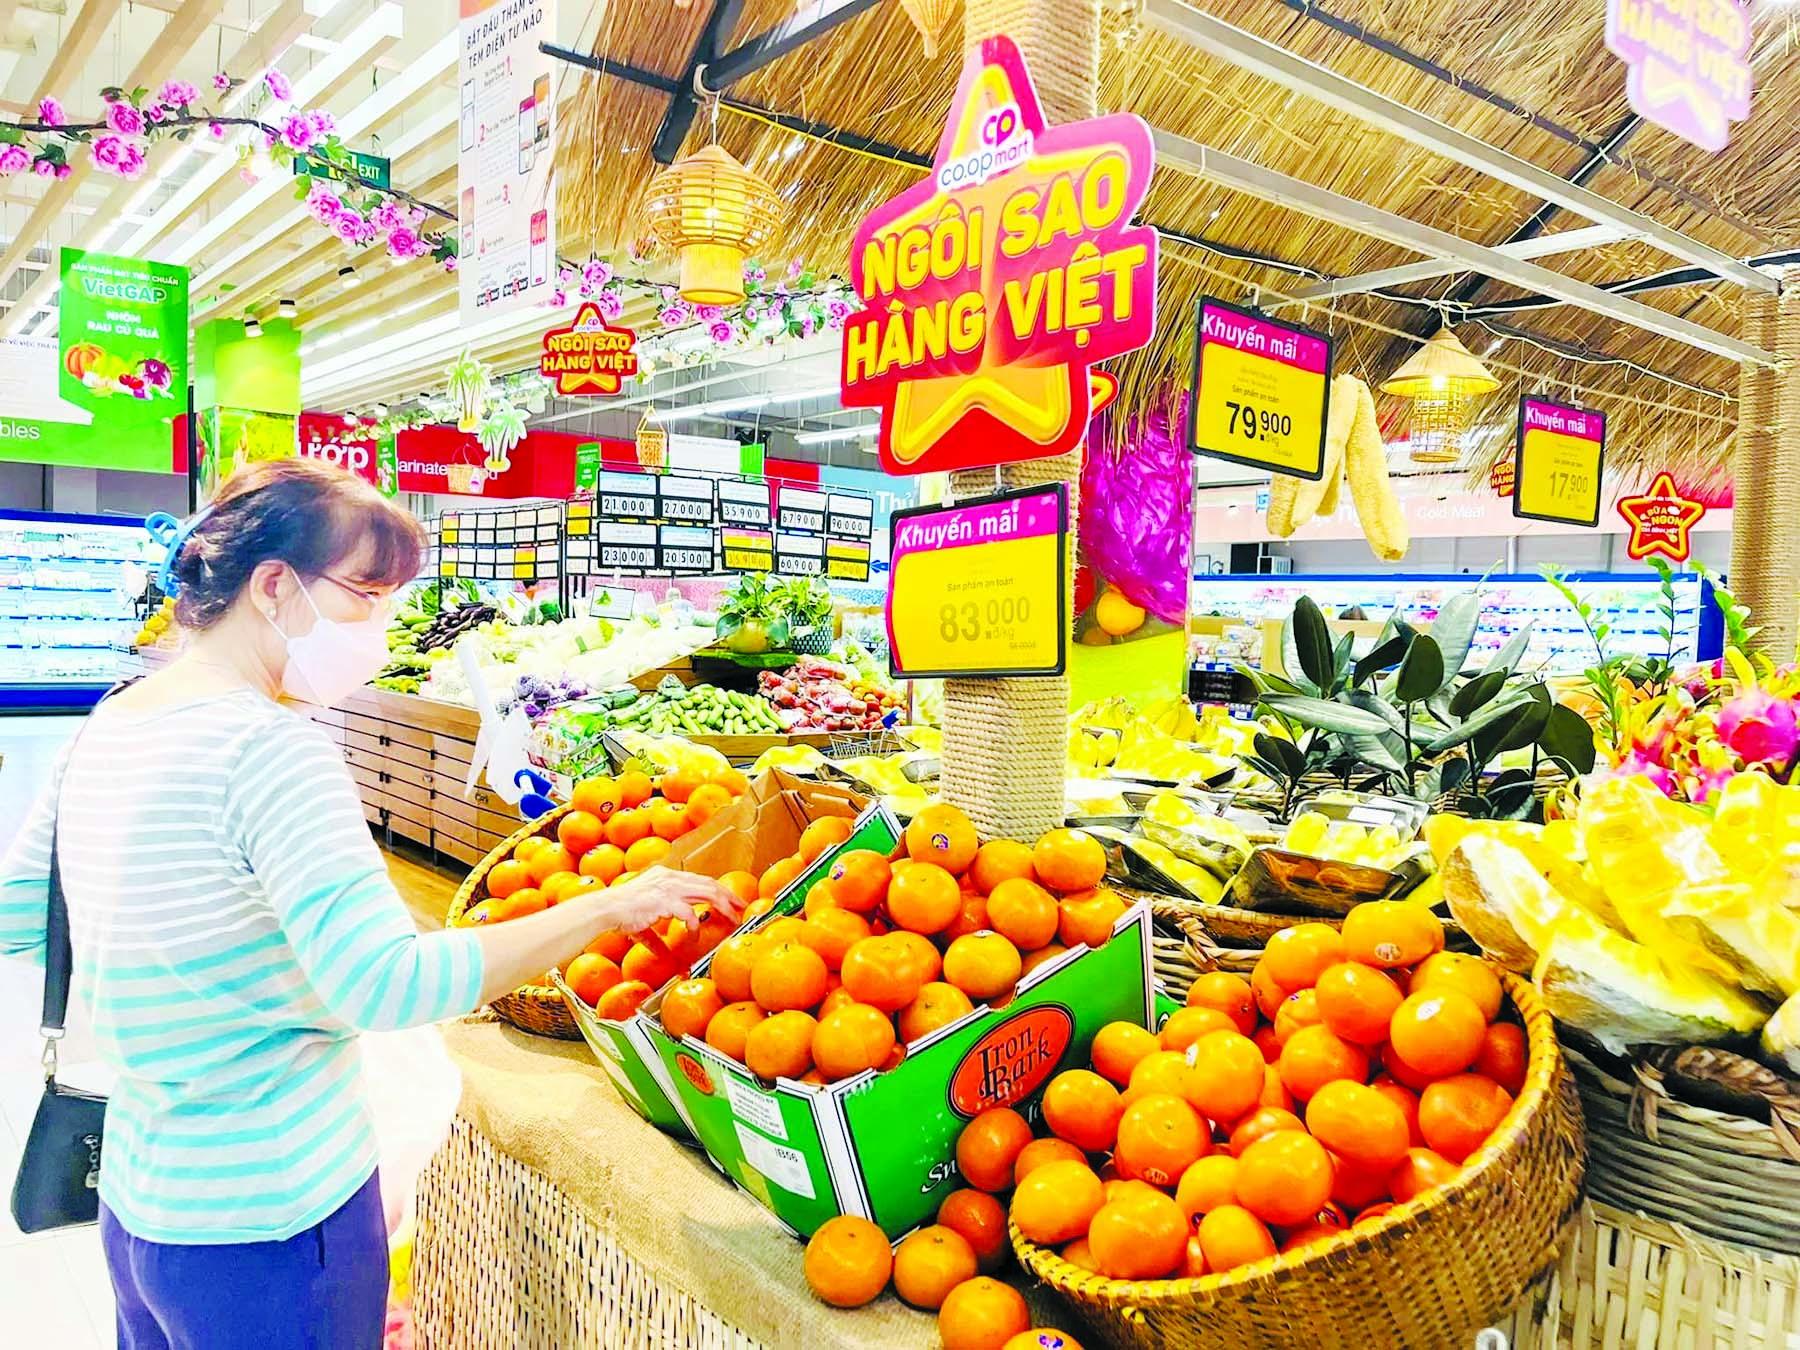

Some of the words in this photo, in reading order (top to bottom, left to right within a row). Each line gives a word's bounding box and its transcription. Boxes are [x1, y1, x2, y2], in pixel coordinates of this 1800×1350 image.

[359, 163, 380, 180] EXIT
[864, 198, 983, 300] NGÔI
[1000, 151, 1127, 258] SAO
[84, 278, 167, 305] VietGAP
[846, 290, 986, 386] HÀNG
[1004, 240, 1148, 349] VIỆT
[1202, 312, 1265, 351] Khuyến
[542, 353, 591, 372] HÀNG
[596, 352, 636, 373] VIỆT
[548, 334, 590, 352] NGÔI
[595, 334, 631, 351] SAO
[1525, 405, 1565, 431] Khuyến
[898, 513, 973, 549] Khuyến
[979, 509, 1019, 537] mãi
[977, 1025, 1034, 1100] Iron
[989, 1026, 1053, 1104] Bark
